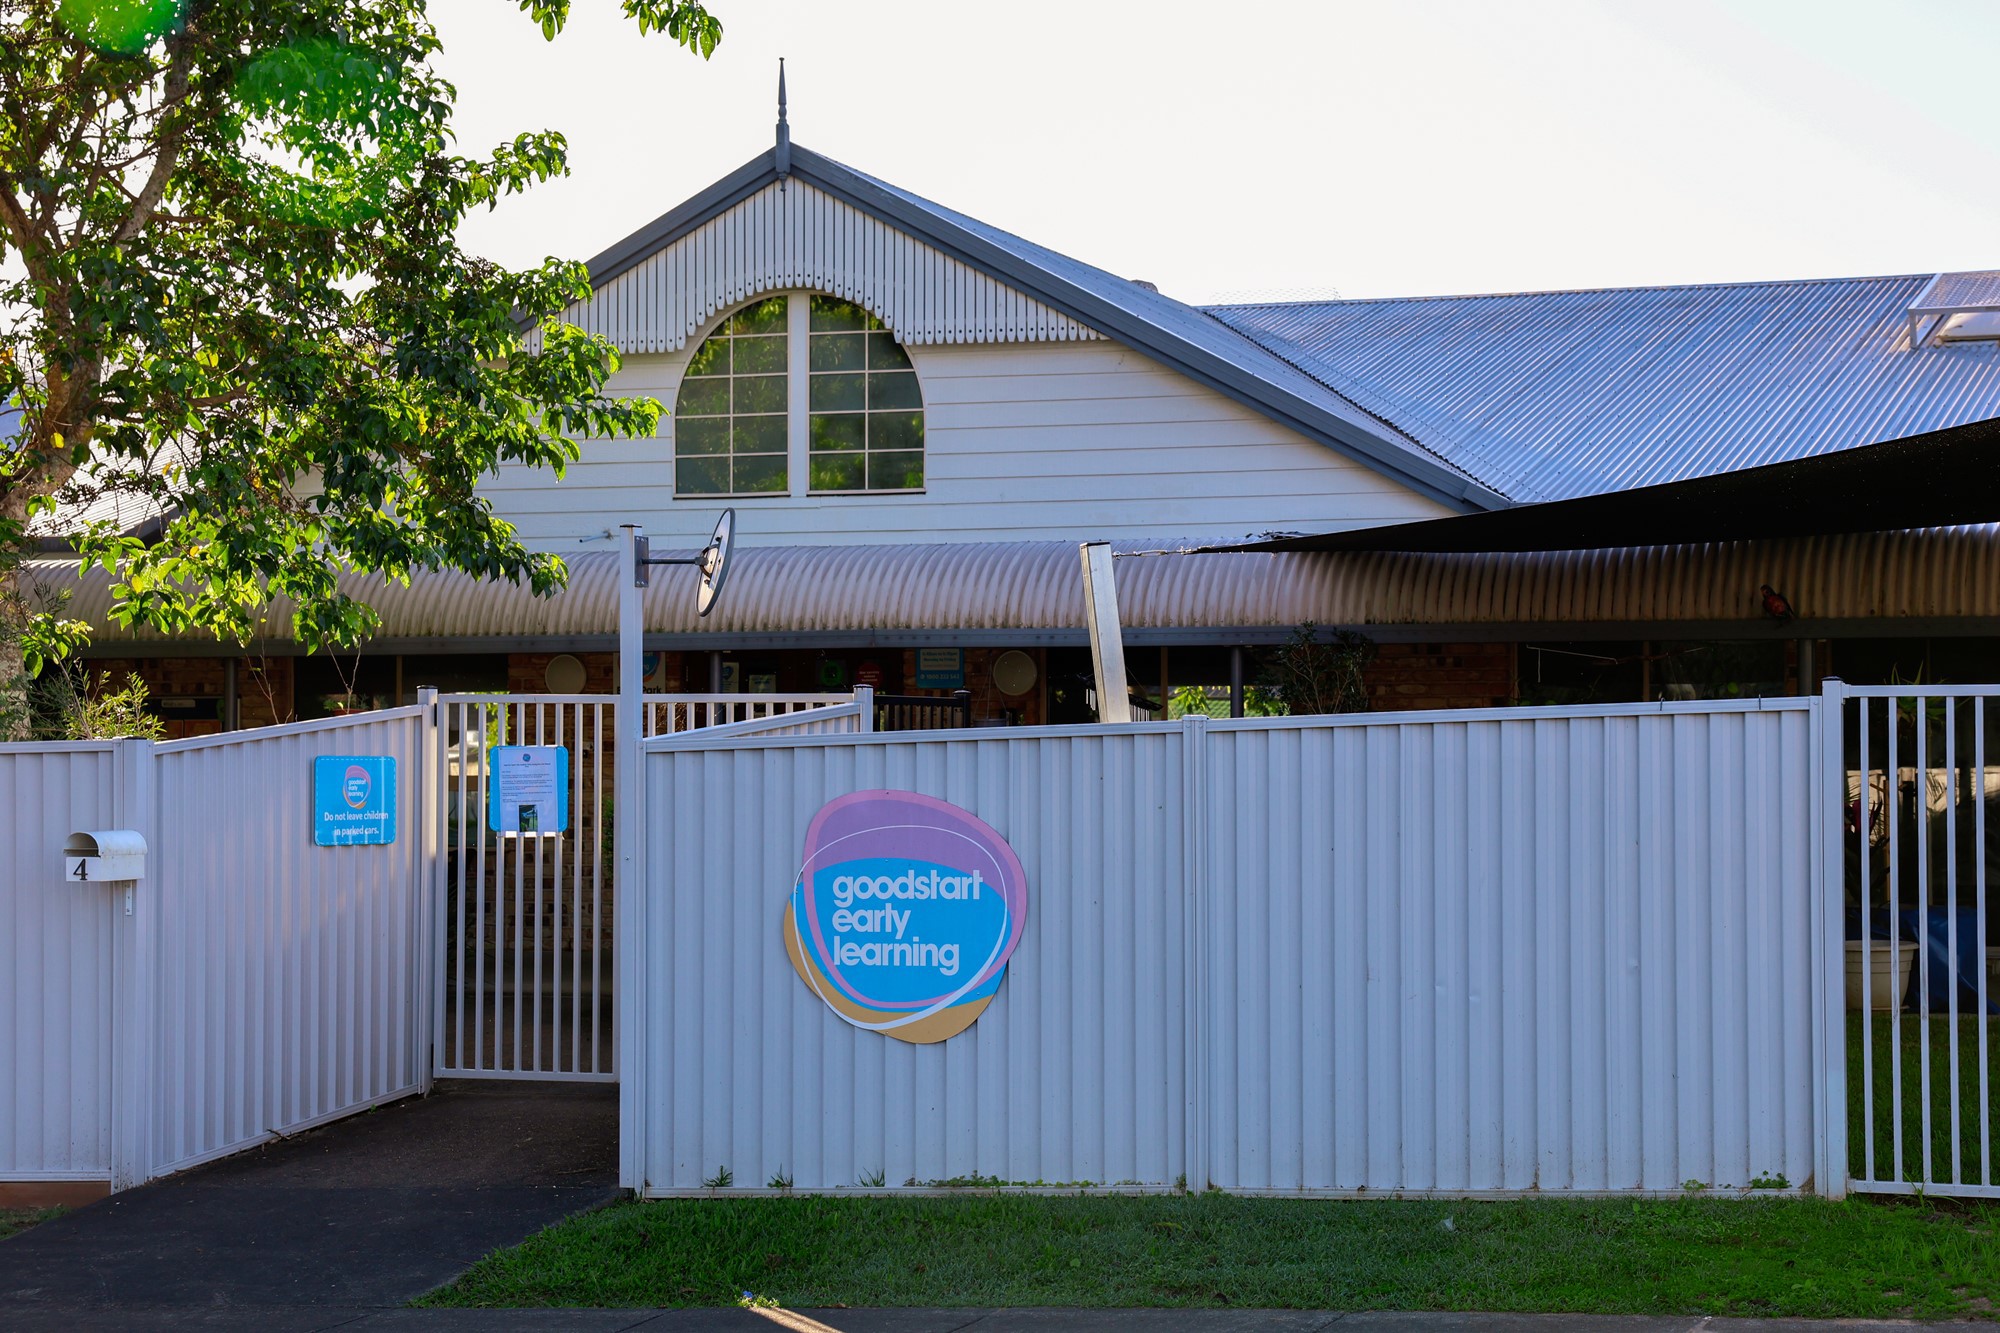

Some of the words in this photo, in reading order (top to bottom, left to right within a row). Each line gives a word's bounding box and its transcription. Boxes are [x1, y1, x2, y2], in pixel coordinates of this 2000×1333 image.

[324, 811, 334, 821] Do
[334, 812, 346, 821] not
[346, 811, 363, 821] leave
[363, 810, 389, 820] children
[334, 826, 341, 836] in
[341, 825, 364, 837] parked
[364, 826, 379, 835] cars.
[73, 858, 88, 880] 4
[833, 870, 983, 908] goodstart
[832, 903, 911, 940] early
[833, 936, 960, 976] learning
